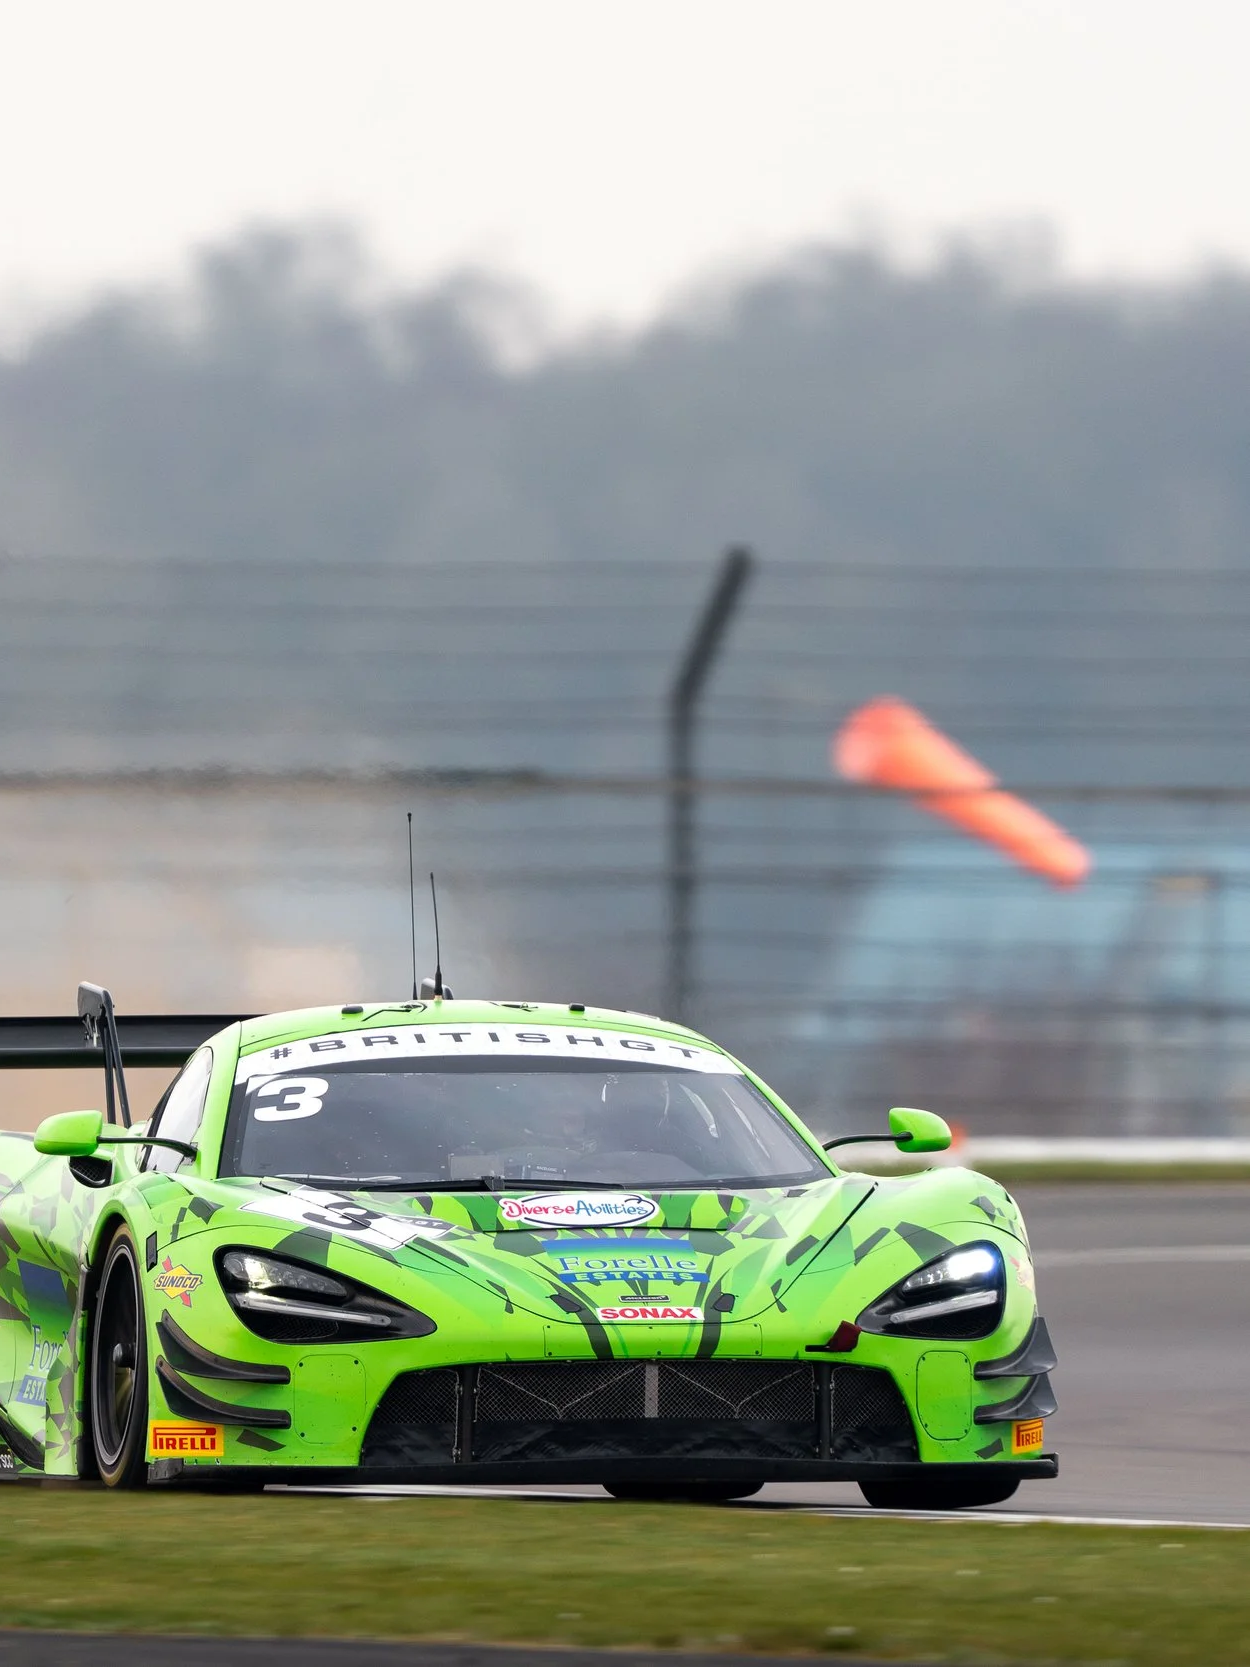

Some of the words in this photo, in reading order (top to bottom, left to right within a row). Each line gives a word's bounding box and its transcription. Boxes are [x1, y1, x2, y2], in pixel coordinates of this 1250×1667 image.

[270, 1031, 702, 1060] #BRITISHGT
[253, 1076, 329, 1122] 3
[302, 1201, 384, 1231] 3
[555, 1254, 697, 1271] Forelle
[155, 1274, 199, 1290] SUNOCO
[574, 1271, 695, 1281] ESTATES
[600, 1307, 698, 1319] SONAX
[22, 1378, 46, 1402] ESTA
[153, 1427, 216, 1451] PIRELLI
[1016, 1419, 1043, 1447] PIRELL
